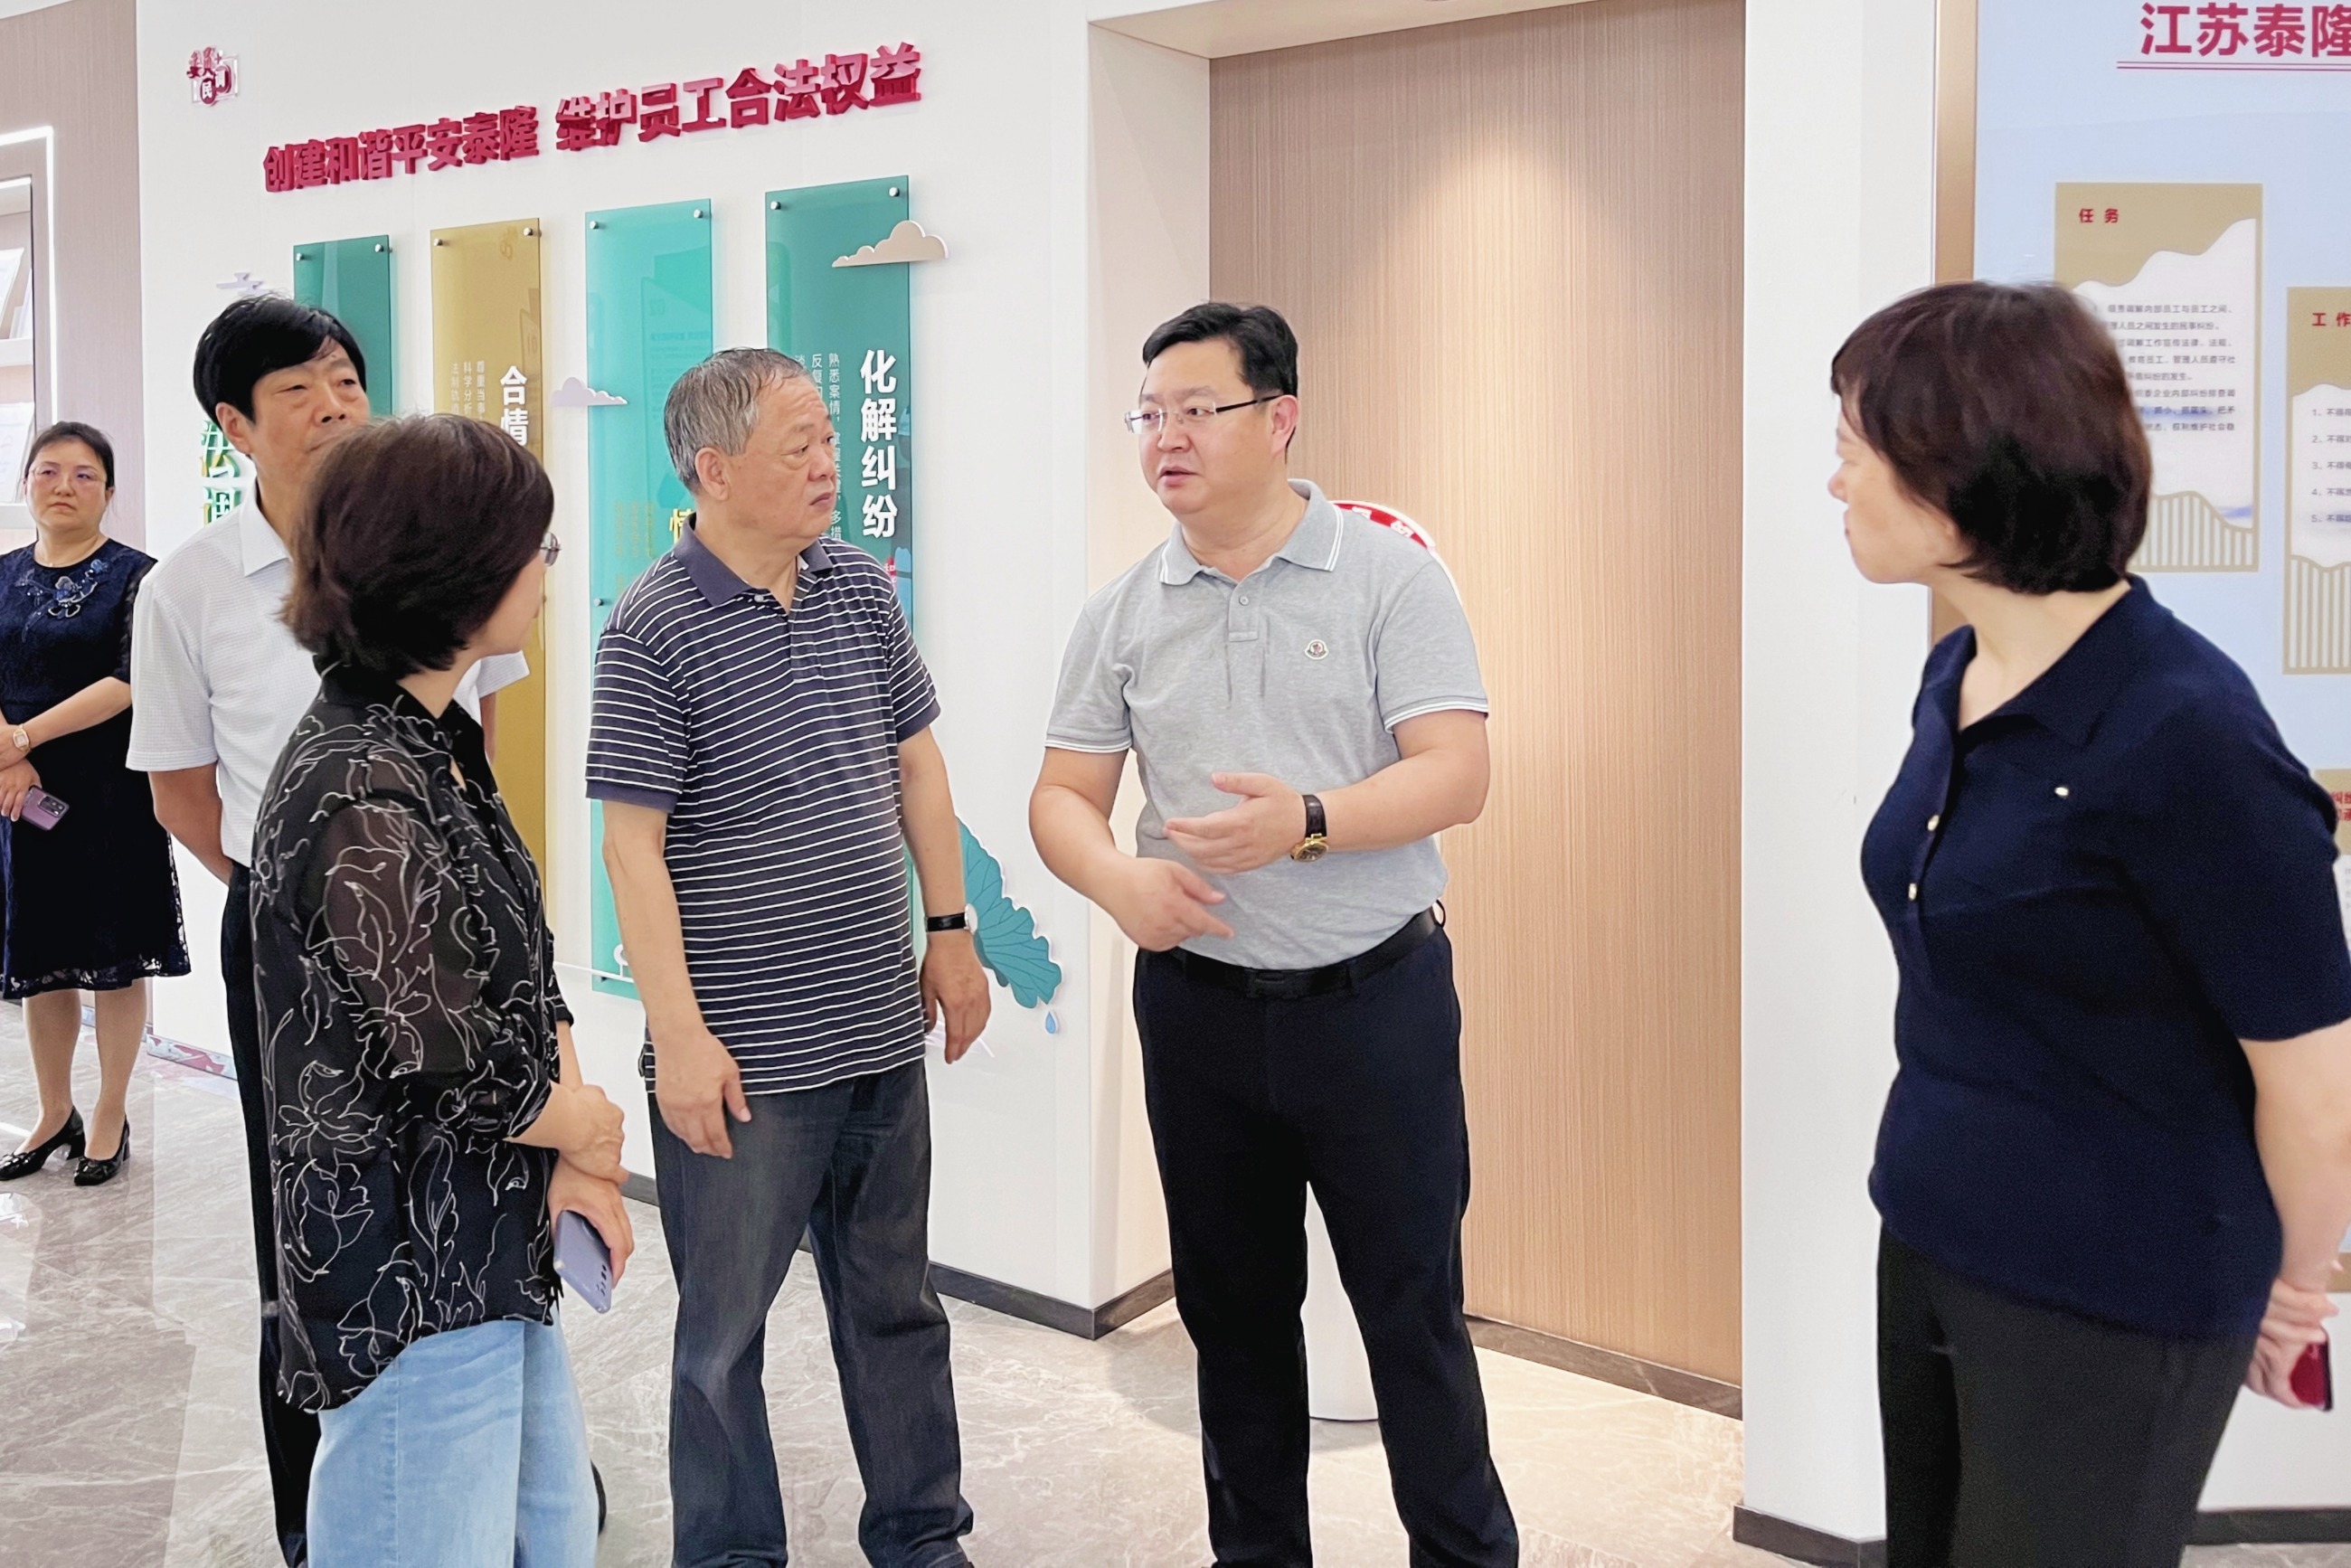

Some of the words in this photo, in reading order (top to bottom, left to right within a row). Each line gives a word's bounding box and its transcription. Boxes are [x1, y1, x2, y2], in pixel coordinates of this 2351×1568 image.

[2140, 3, 2351, 58] 江苏泰隆
[263, 105, 540, 192] 创建和谐平安泰隆
[555, 42, 921, 152] 维护员工合法权益
[2079, 208, 2120, 224] 任务
[477, 361, 486, 419] 尊重当事
[860, 349, 898, 538] 化解纠纷
